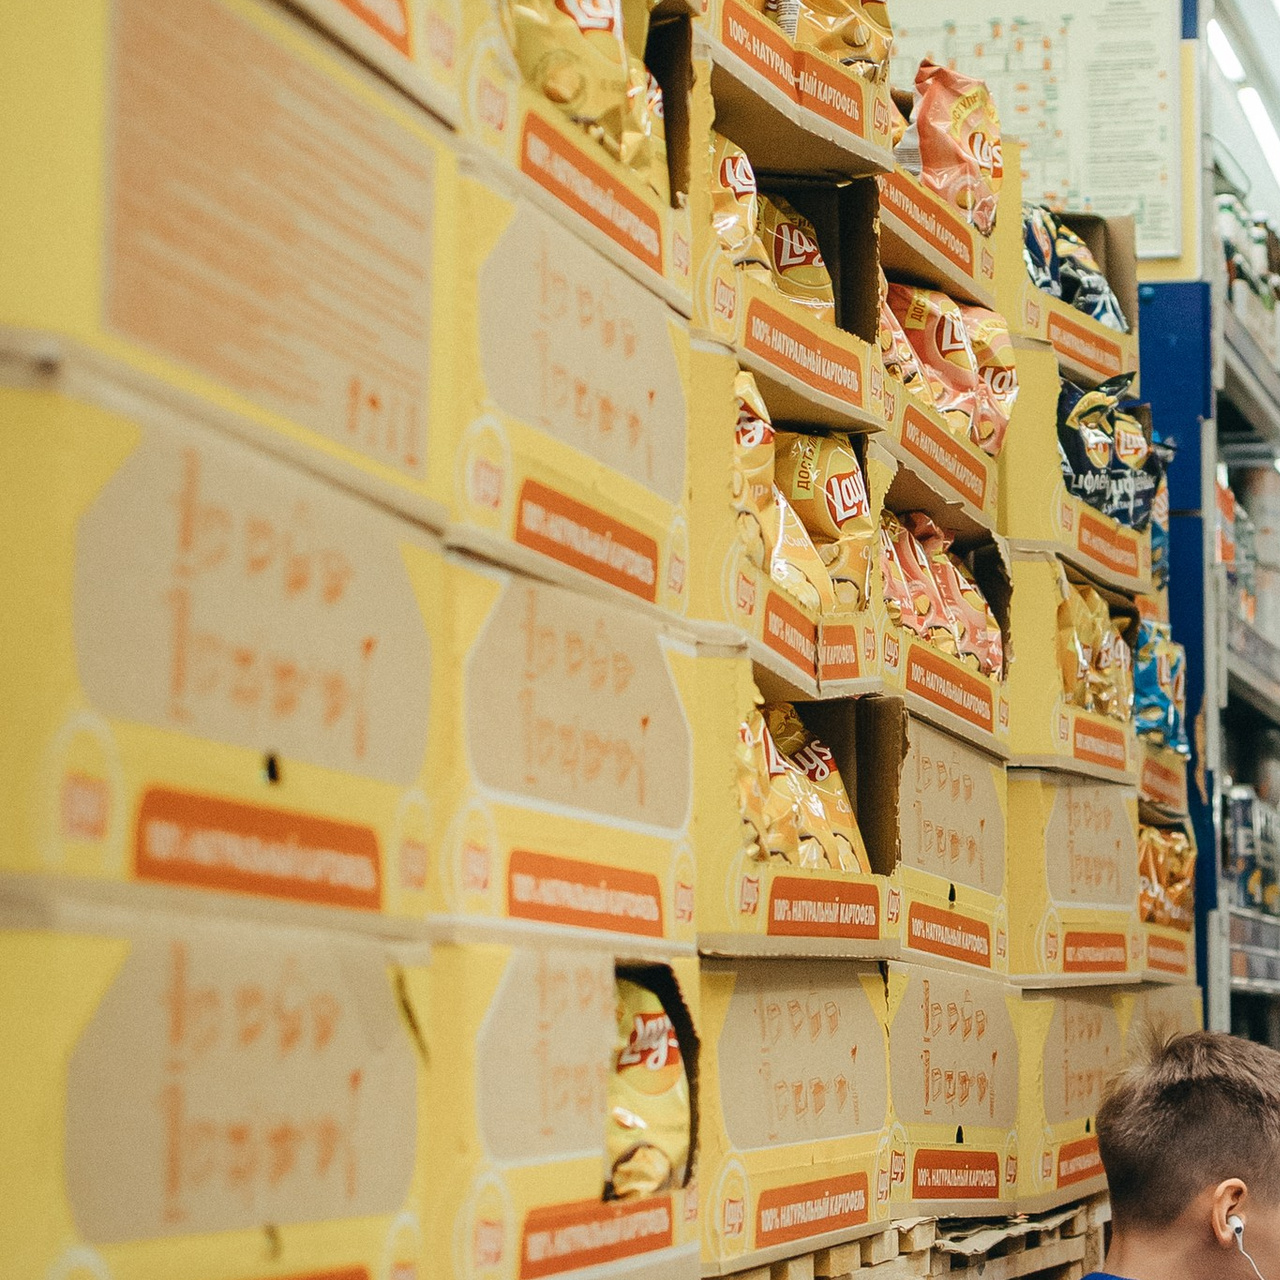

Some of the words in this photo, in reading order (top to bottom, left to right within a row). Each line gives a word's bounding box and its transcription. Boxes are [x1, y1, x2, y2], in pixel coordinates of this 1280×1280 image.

[727, 16, 751, 51] 100%
[816, 81, 860, 122] КАРТОФЕЛЬ
[752, 316, 772, 346] 100%
[772, 334, 822, 378] НАТУРАЛЬНЫЙ
[821, 358, 859, 393] КАРТОФЕЛЬ
[926, 670, 964, 706] НАТУРАЛЬНЫЙ
[791, 896, 840, 924] НАТУРАЛЬНЫЙ
[839, 902, 876, 926] КАРТОФЕЛЬ
[925, 924, 962, 948] НАТУРАЛЬНЫЙ
[917, 1169, 931, 1187] 100%
[931, 1165, 969, 1187] НАТУРАЛЬНЫЙ
[968, 1169, 998, 1188] КАРТОФЕЛЬ
[760, 1206, 780, 1233] 100%
[779, 1190, 830, 1227] НАТУРАЛЬНЫЙ
[828, 1188, 866, 1218] КАРТОФЕЛЬ
